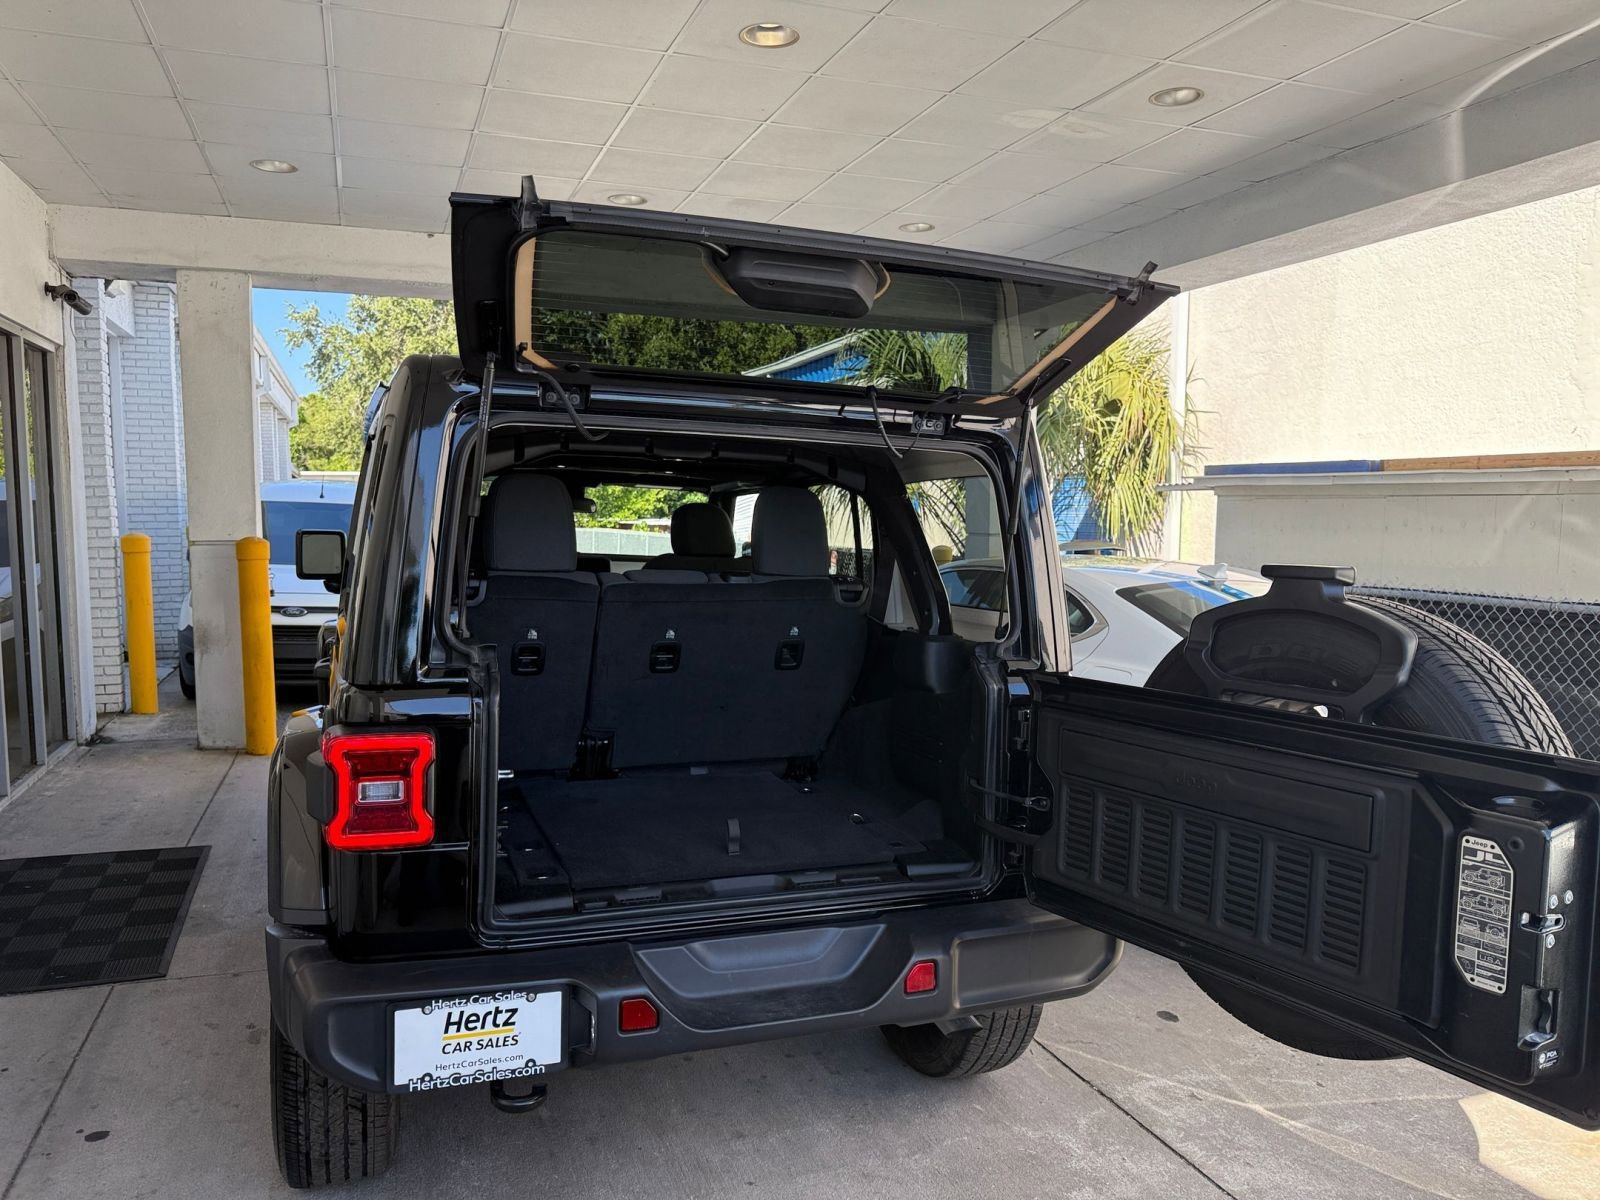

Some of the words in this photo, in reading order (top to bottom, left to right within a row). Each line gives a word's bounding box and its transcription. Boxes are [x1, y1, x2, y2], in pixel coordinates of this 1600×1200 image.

[1471, 840, 1489, 848] Jeep
[1463, 850, 1506, 865] JL
[431, 998, 468, 1010] Hertz
[469, 994, 494, 1005] Car
[495, 990, 527, 1002] Sales
[443, 1006, 518, 1034] Hertz
[441, 1040, 473, 1054] CAR
[475, 1034, 519, 1050] SALES
[435, 1054, 524, 1071] HertzCarSales.com
[409, 1065, 545, 1092] HertzCarSales.com
